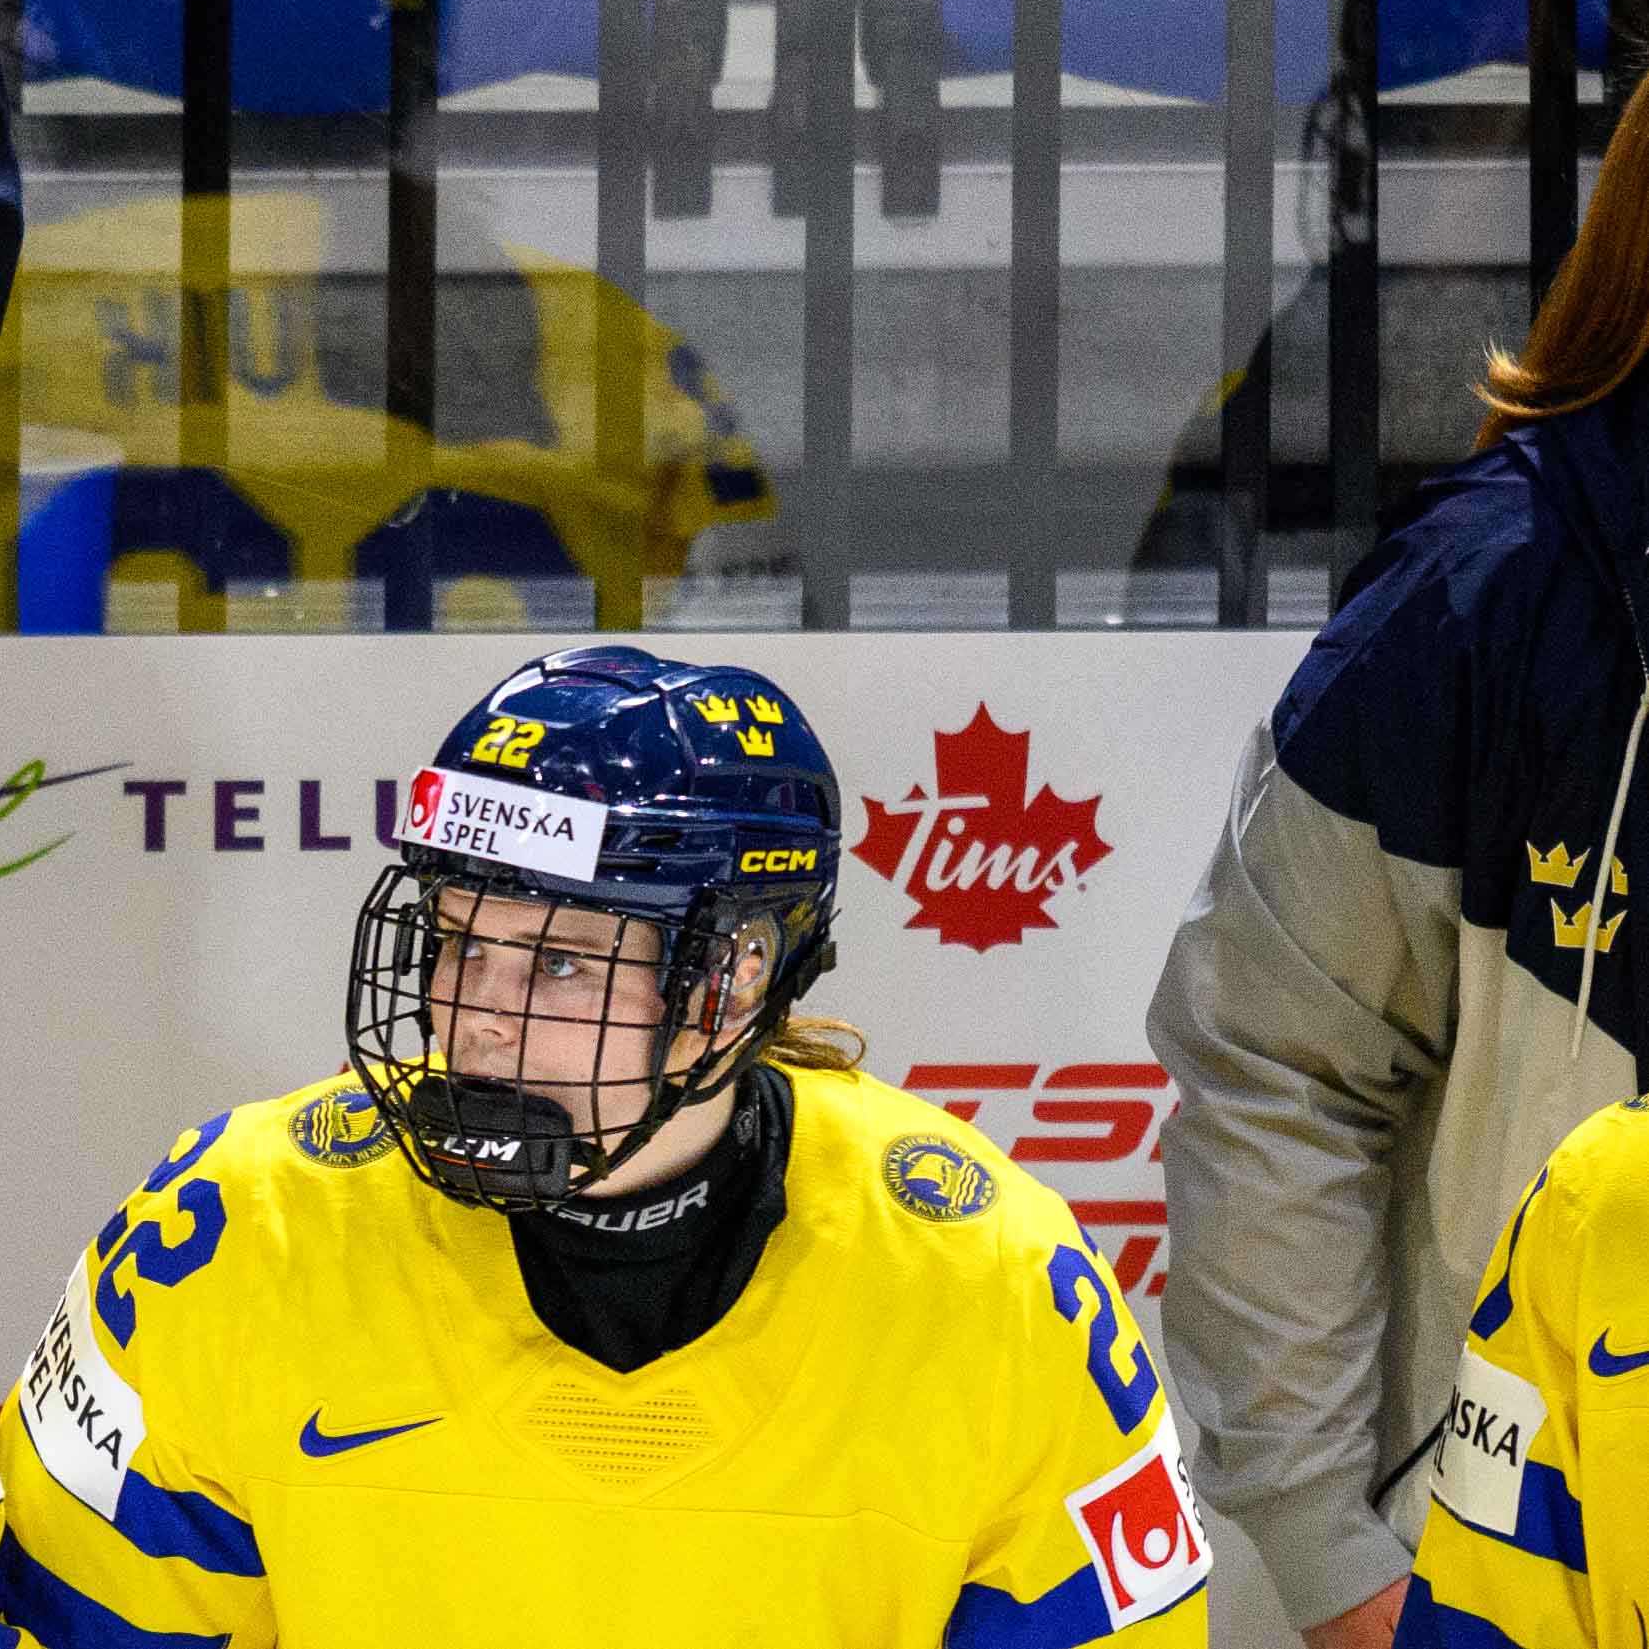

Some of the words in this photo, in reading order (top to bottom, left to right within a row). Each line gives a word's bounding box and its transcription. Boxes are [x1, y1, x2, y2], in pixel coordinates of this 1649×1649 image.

[472, 718, 547, 770] 22
[123, 779, 401, 852] TELU
[438, 825, 501, 856] SPEL
[446, 790, 576, 843] SVENSKA
[883, 794, 1083, 896] Tims
[739, 849, 818, 873] CCM
[901, 1063, 1181, 1163] TS
[546, 1180, 710, 1233] AUER
[29, 1337, 53, 1424] PEL
[50, 1295, 123, 1471] VENSKA
